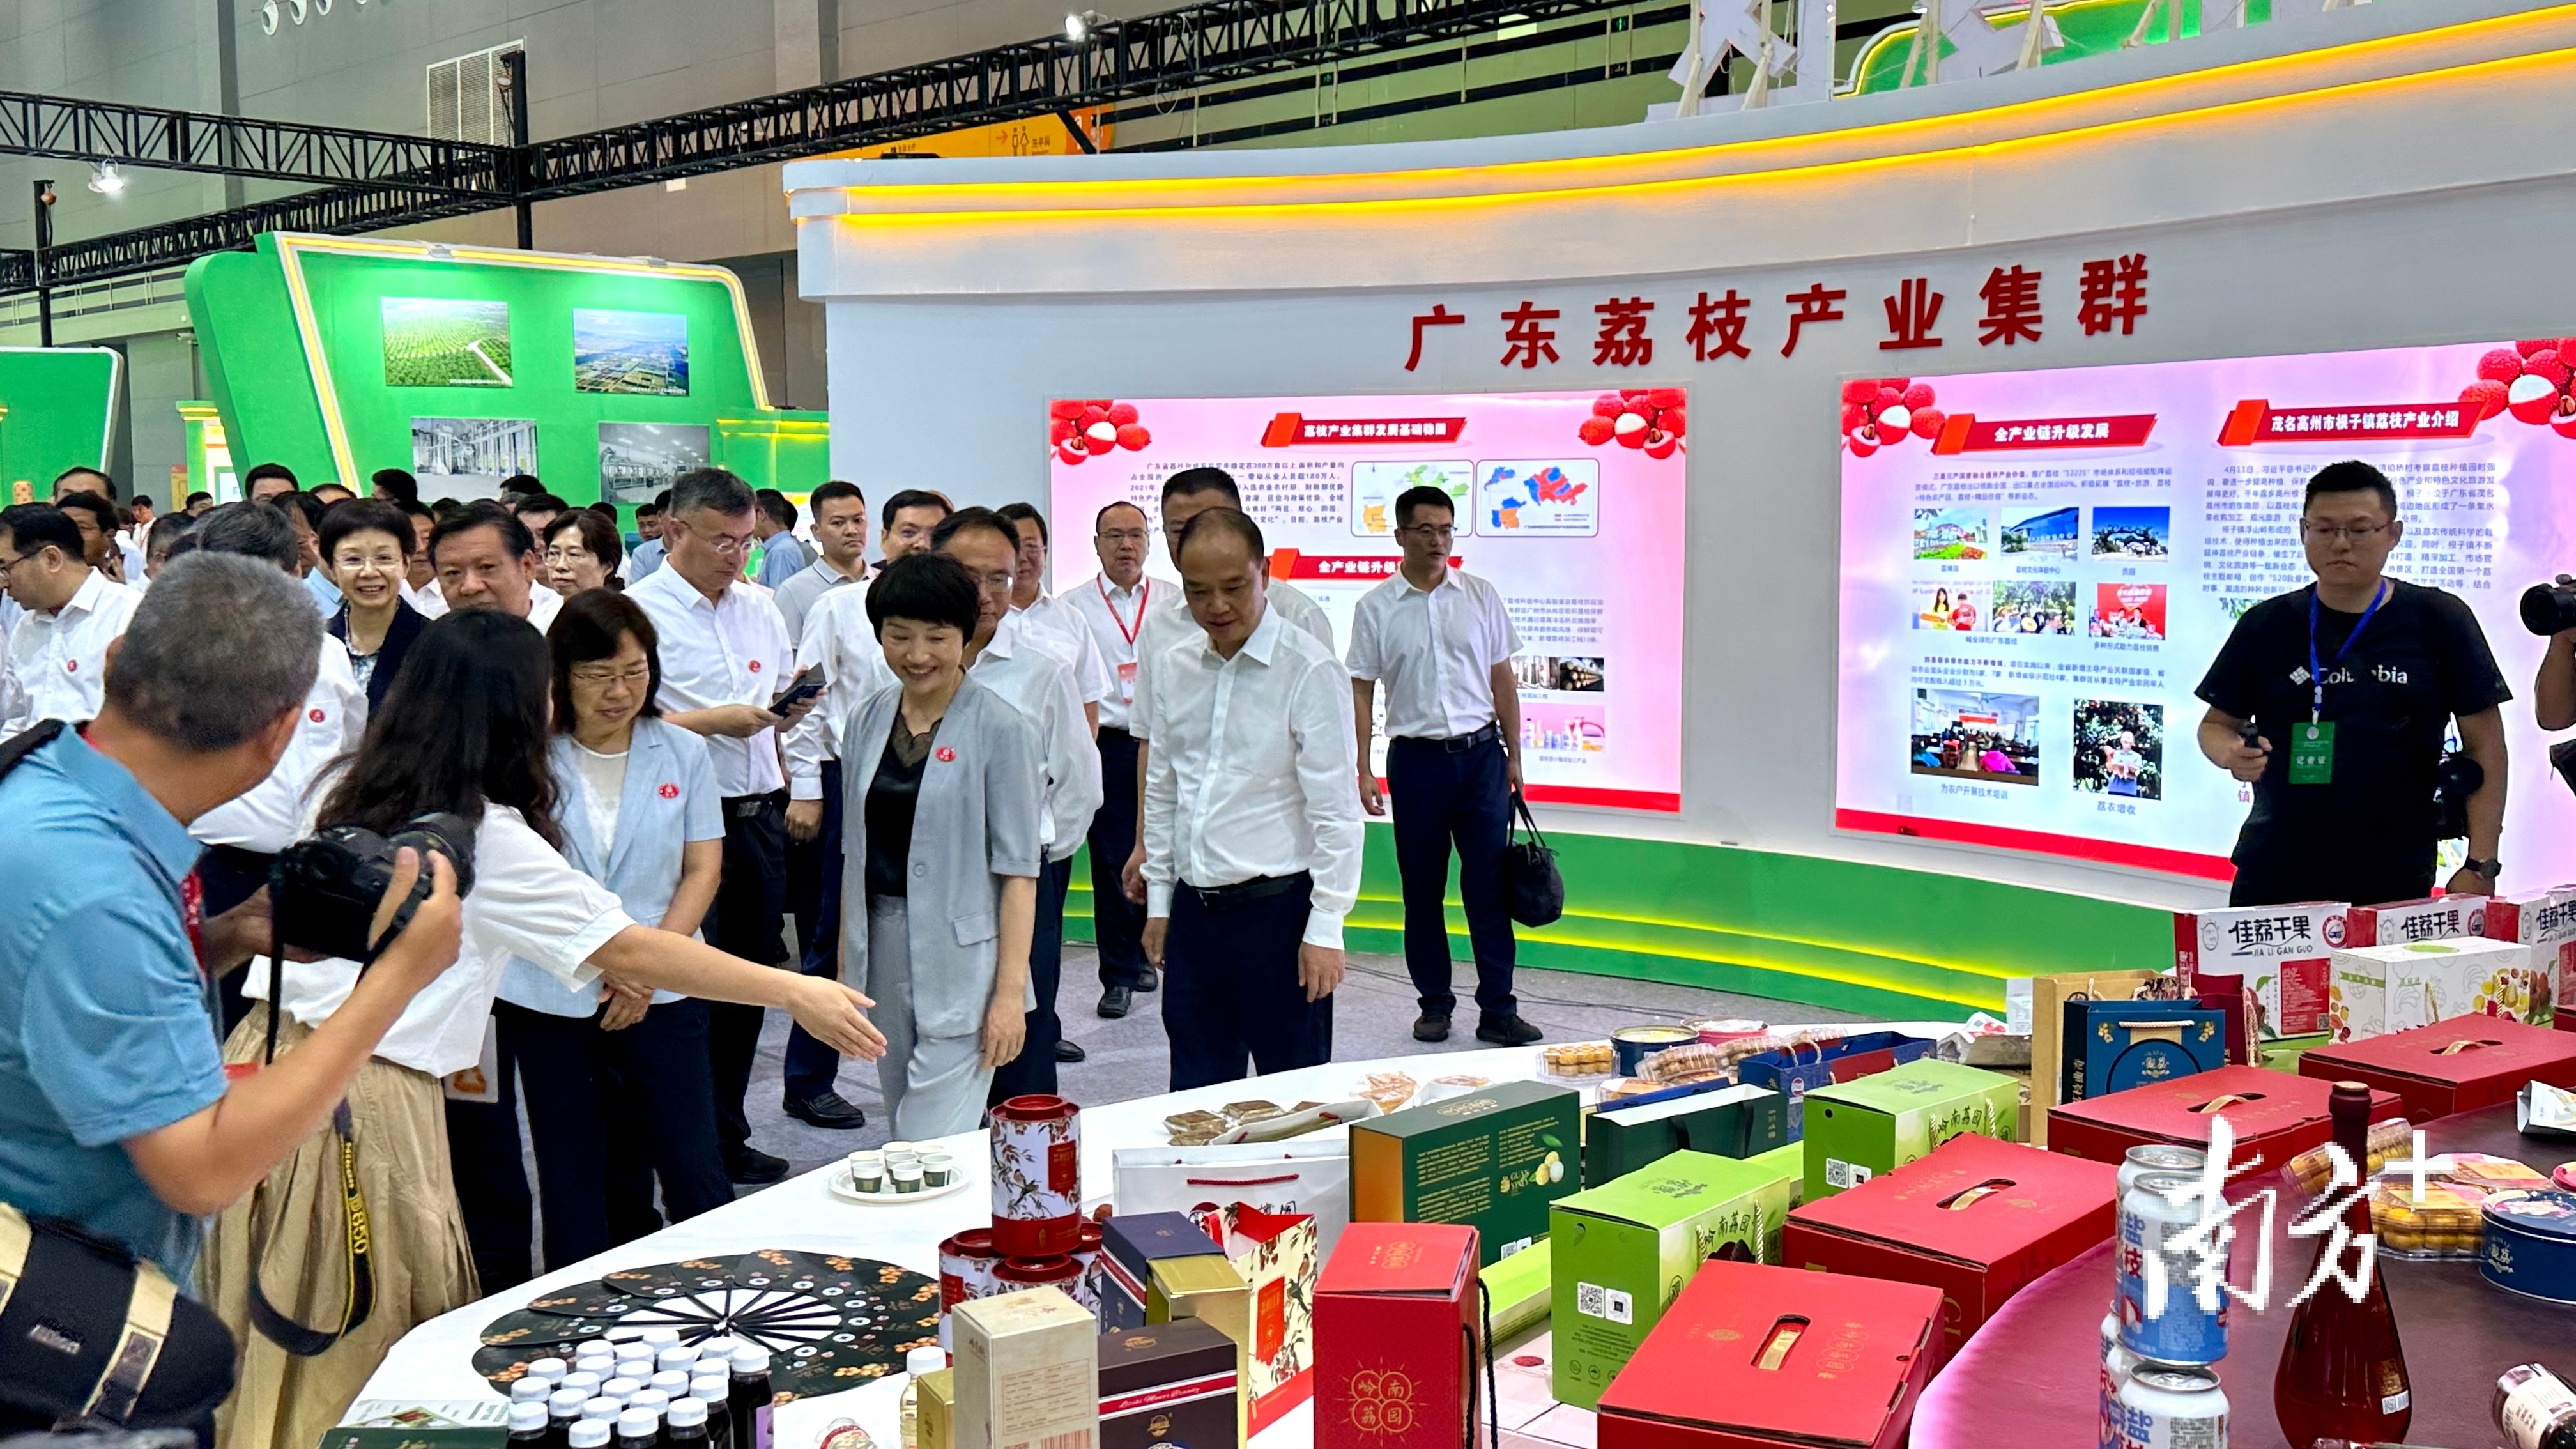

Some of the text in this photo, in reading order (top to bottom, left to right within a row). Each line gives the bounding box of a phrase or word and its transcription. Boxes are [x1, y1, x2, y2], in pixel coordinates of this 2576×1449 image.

[1402, 252, 2150, 372] 广东荔枝产业集群
[1993, 422, 2110, 443] 全产业链升级发展
[2271, 410, 2460, 433] 茂名高州市根子镇荔枝产业介绍
[1318, 560, 1399, 575] 全产业链升级
[2228, 915, 2312, 943] 佳荔干果
[2401, 909, 2460, 939] 佳荔干果
[2253, 944, 2313, 956] JIA LI GAN GUO
[349, 1197, 368, 1255] D850
[1358, 1379, 1405, 1398] 岭南
[1361, 1407, 1403, 1425] 荔园
